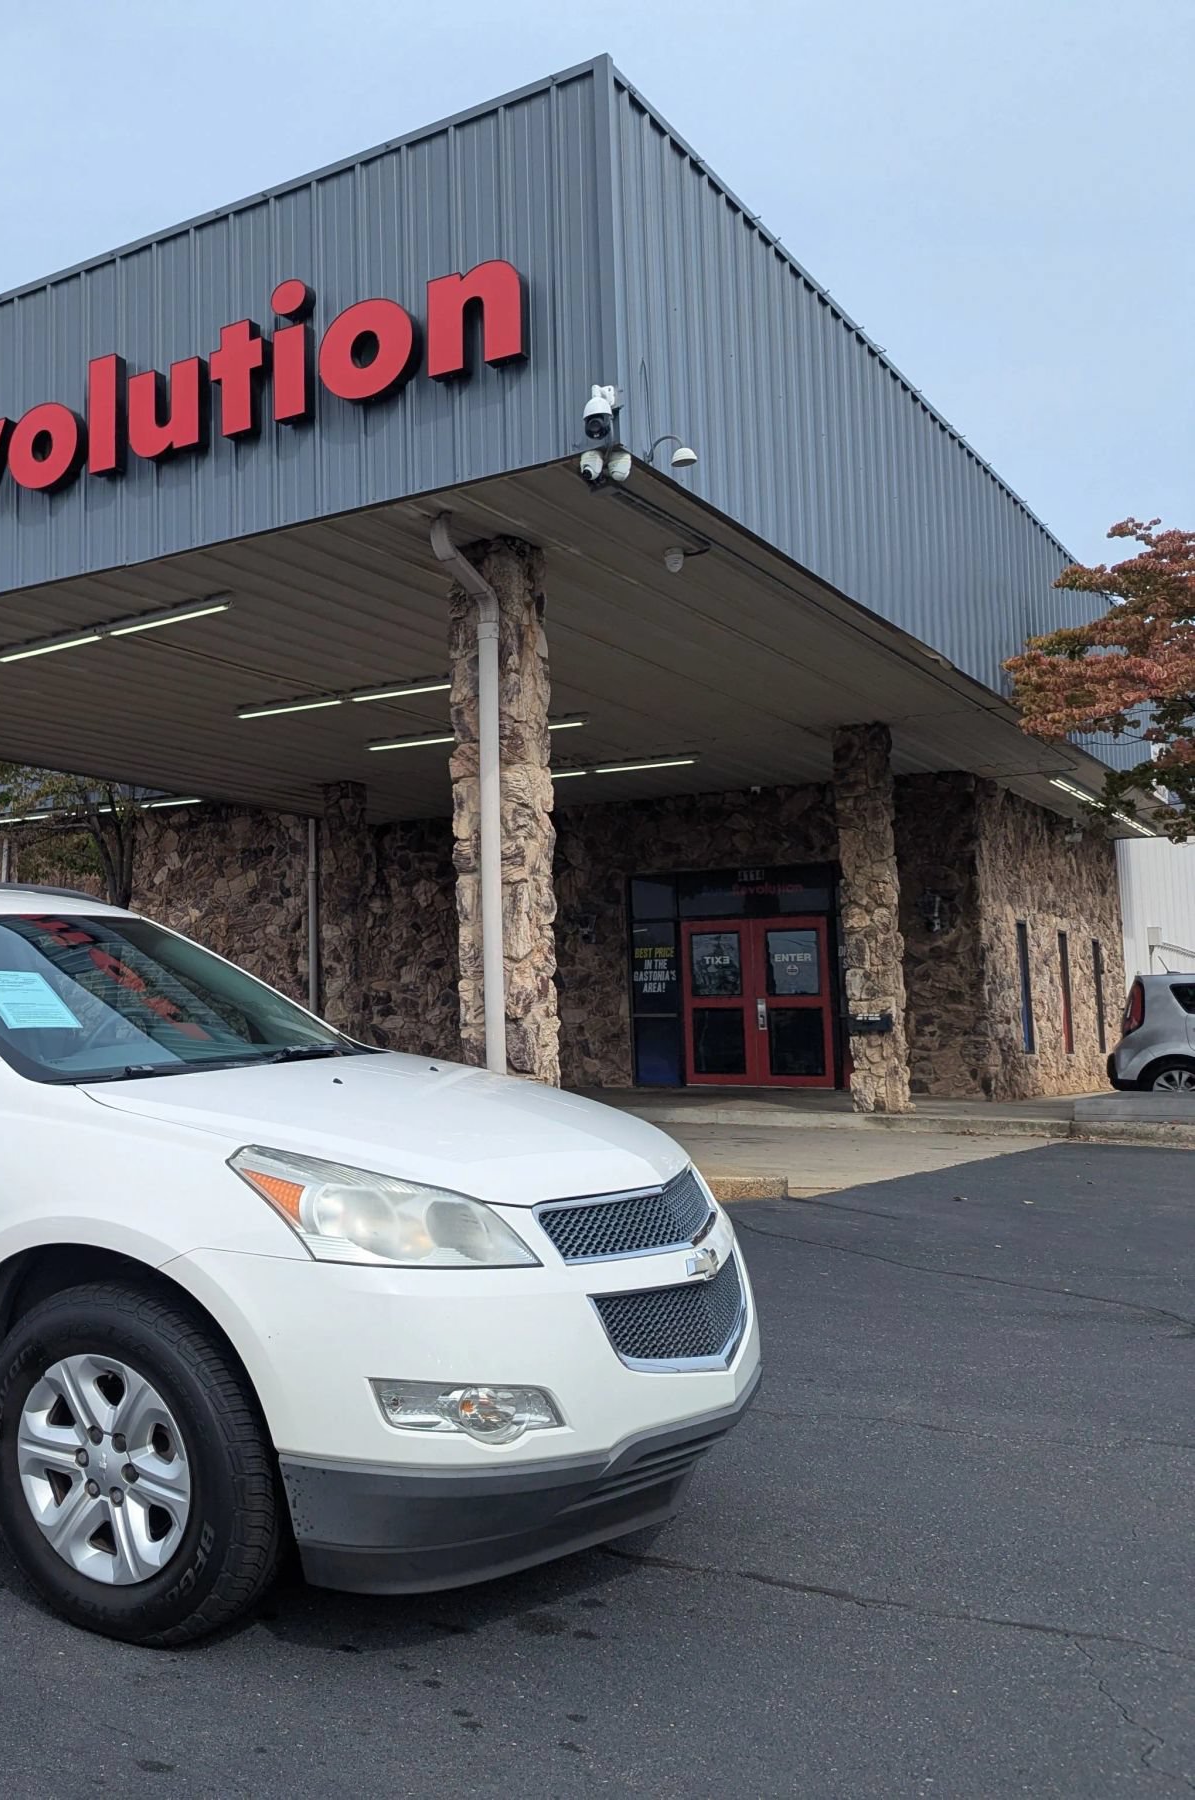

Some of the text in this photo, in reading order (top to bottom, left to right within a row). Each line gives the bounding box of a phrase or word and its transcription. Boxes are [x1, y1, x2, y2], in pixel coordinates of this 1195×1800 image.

[634, 946, 675, 959] BEST PRICE
[774, 952, 812, 963] ENTER
[644, 958, 668, 970] IN THE
[633, 969, 677, 982] GASTONIA'S
[642, 982, 666, 993] AREA!
